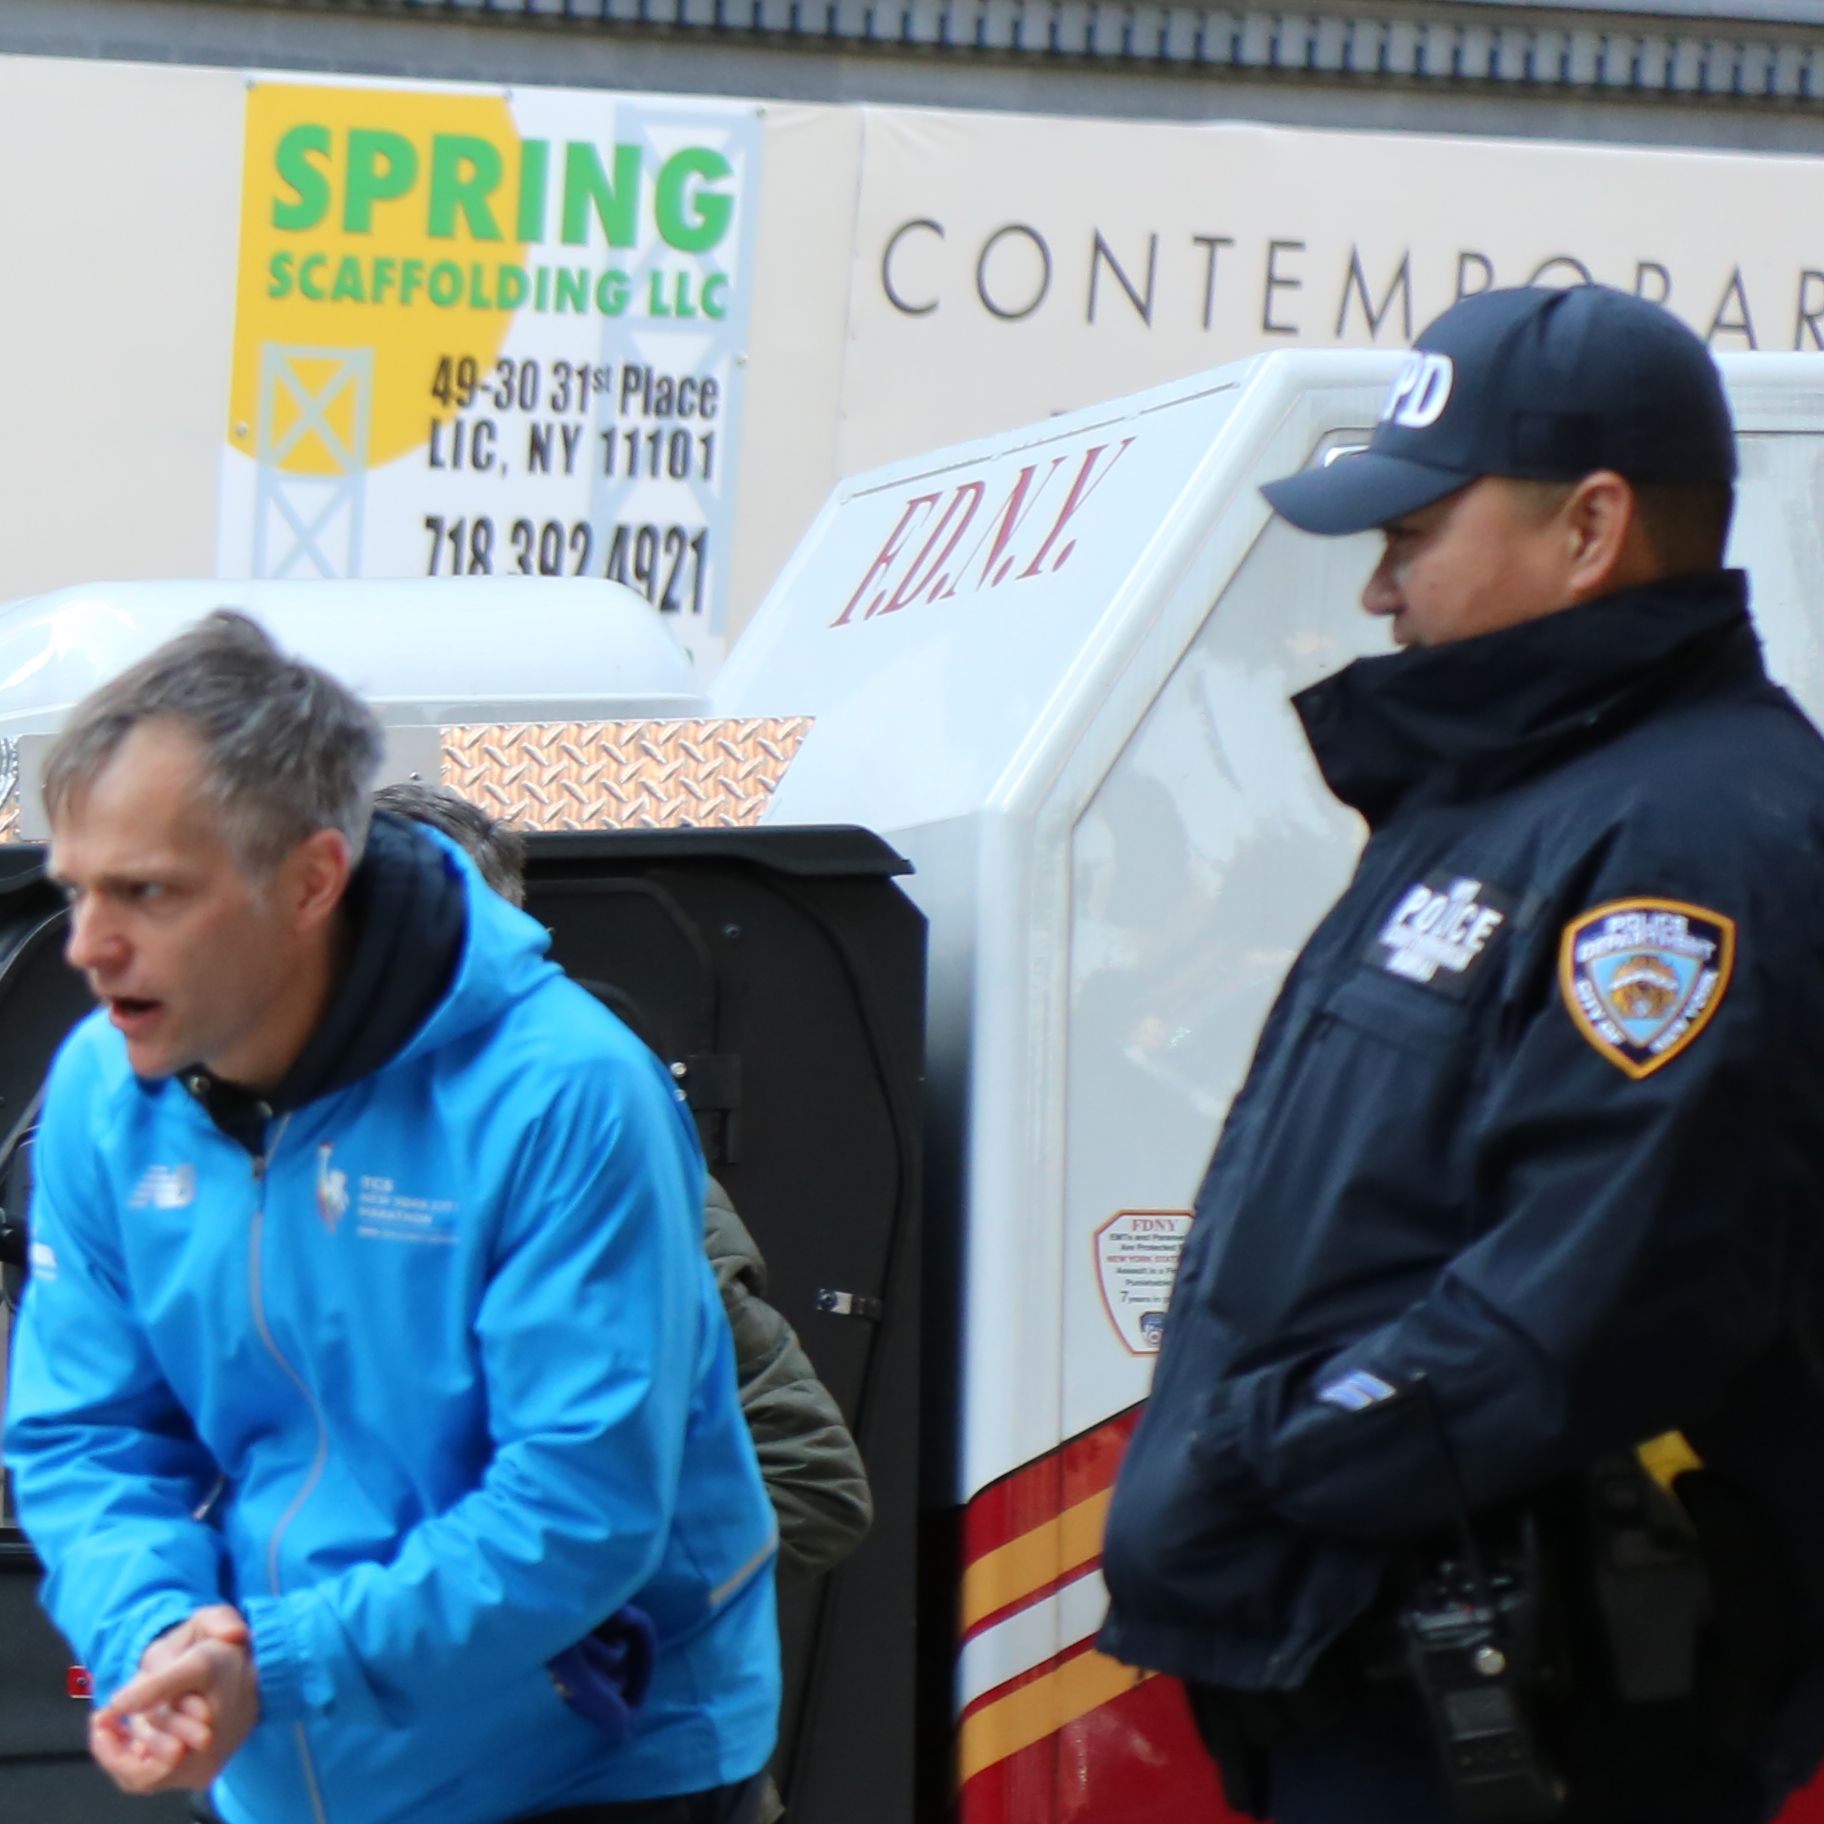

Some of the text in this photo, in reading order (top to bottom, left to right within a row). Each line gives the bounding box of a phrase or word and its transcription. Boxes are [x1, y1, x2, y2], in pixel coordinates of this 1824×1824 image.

[270, 123, 736, 254] SPRING
[267, 251, 731, 321] SCAFFOLDING LLC
[432, 355, 720, 421] 49-30 31st Place
[428, 417, 716, 482] LIC, NY 11101
[425, 515, 495, 576] 718
[1132, 1219, 1178, 1232] FDNY
[1120, 1290, 1130, 1303] 7
